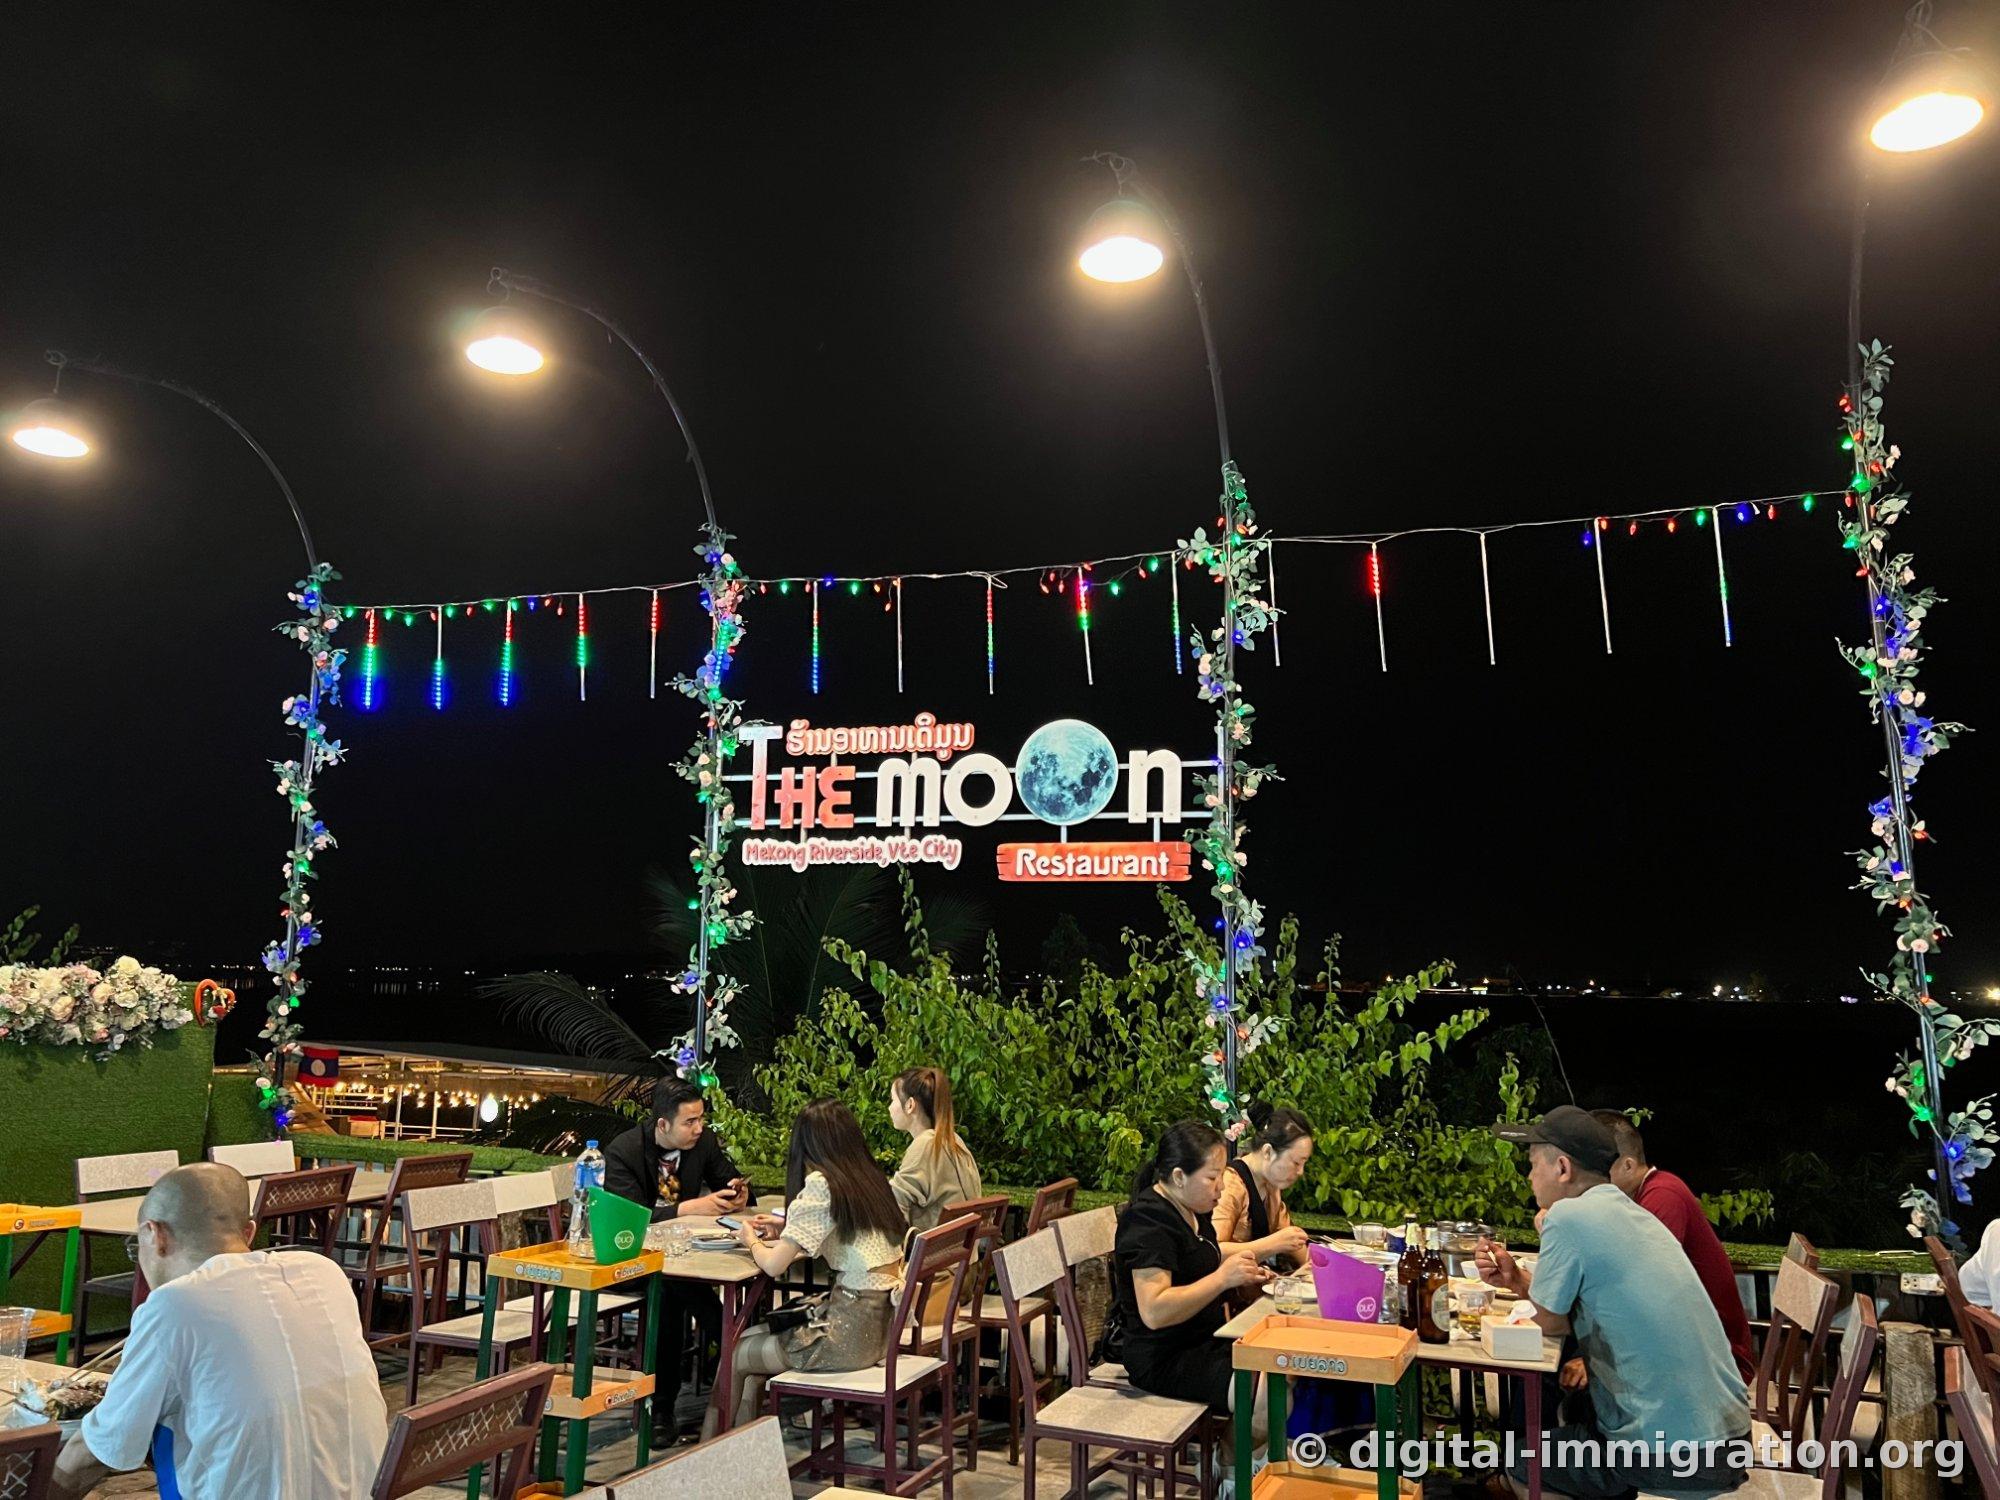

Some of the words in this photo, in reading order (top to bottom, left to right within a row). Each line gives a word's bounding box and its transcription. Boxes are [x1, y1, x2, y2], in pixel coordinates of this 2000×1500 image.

[745, 842, 806, 868] Mekong
[922, 838, 960, 866] City
[1015, 848, 1170, 877] Restaurant
